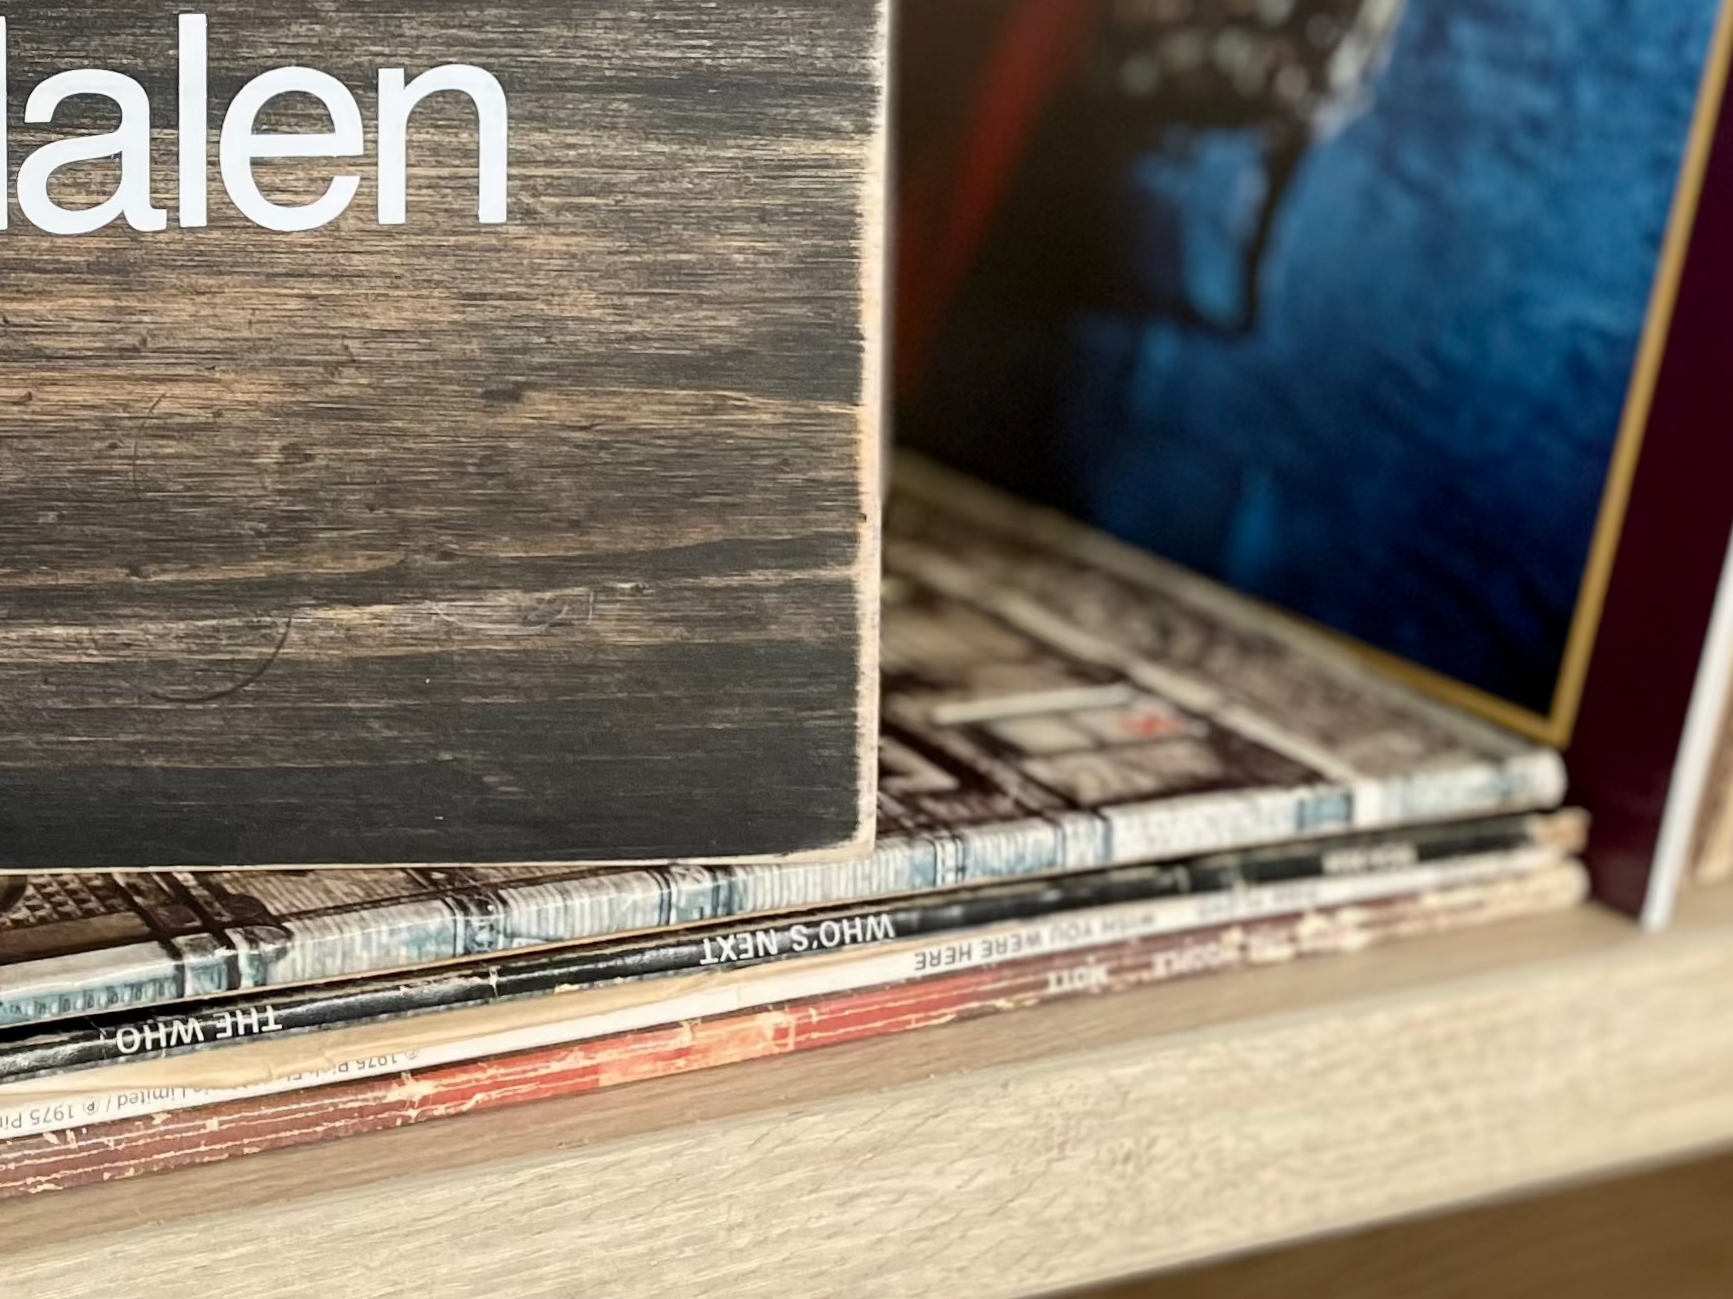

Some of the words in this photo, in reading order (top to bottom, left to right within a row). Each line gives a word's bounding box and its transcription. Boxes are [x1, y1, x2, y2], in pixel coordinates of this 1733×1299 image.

[791, 912, 896, 951] WHO'S
[980, 933, 1044, 961] WERE
[698, 932, 778, 966] NEXT
[913, 944, 972, 972] HERE
[115, 1016, 205, 1056] WHO
[217, 1003, 283, 1041] THE
[29, 1103, 75, 1126] 1975
